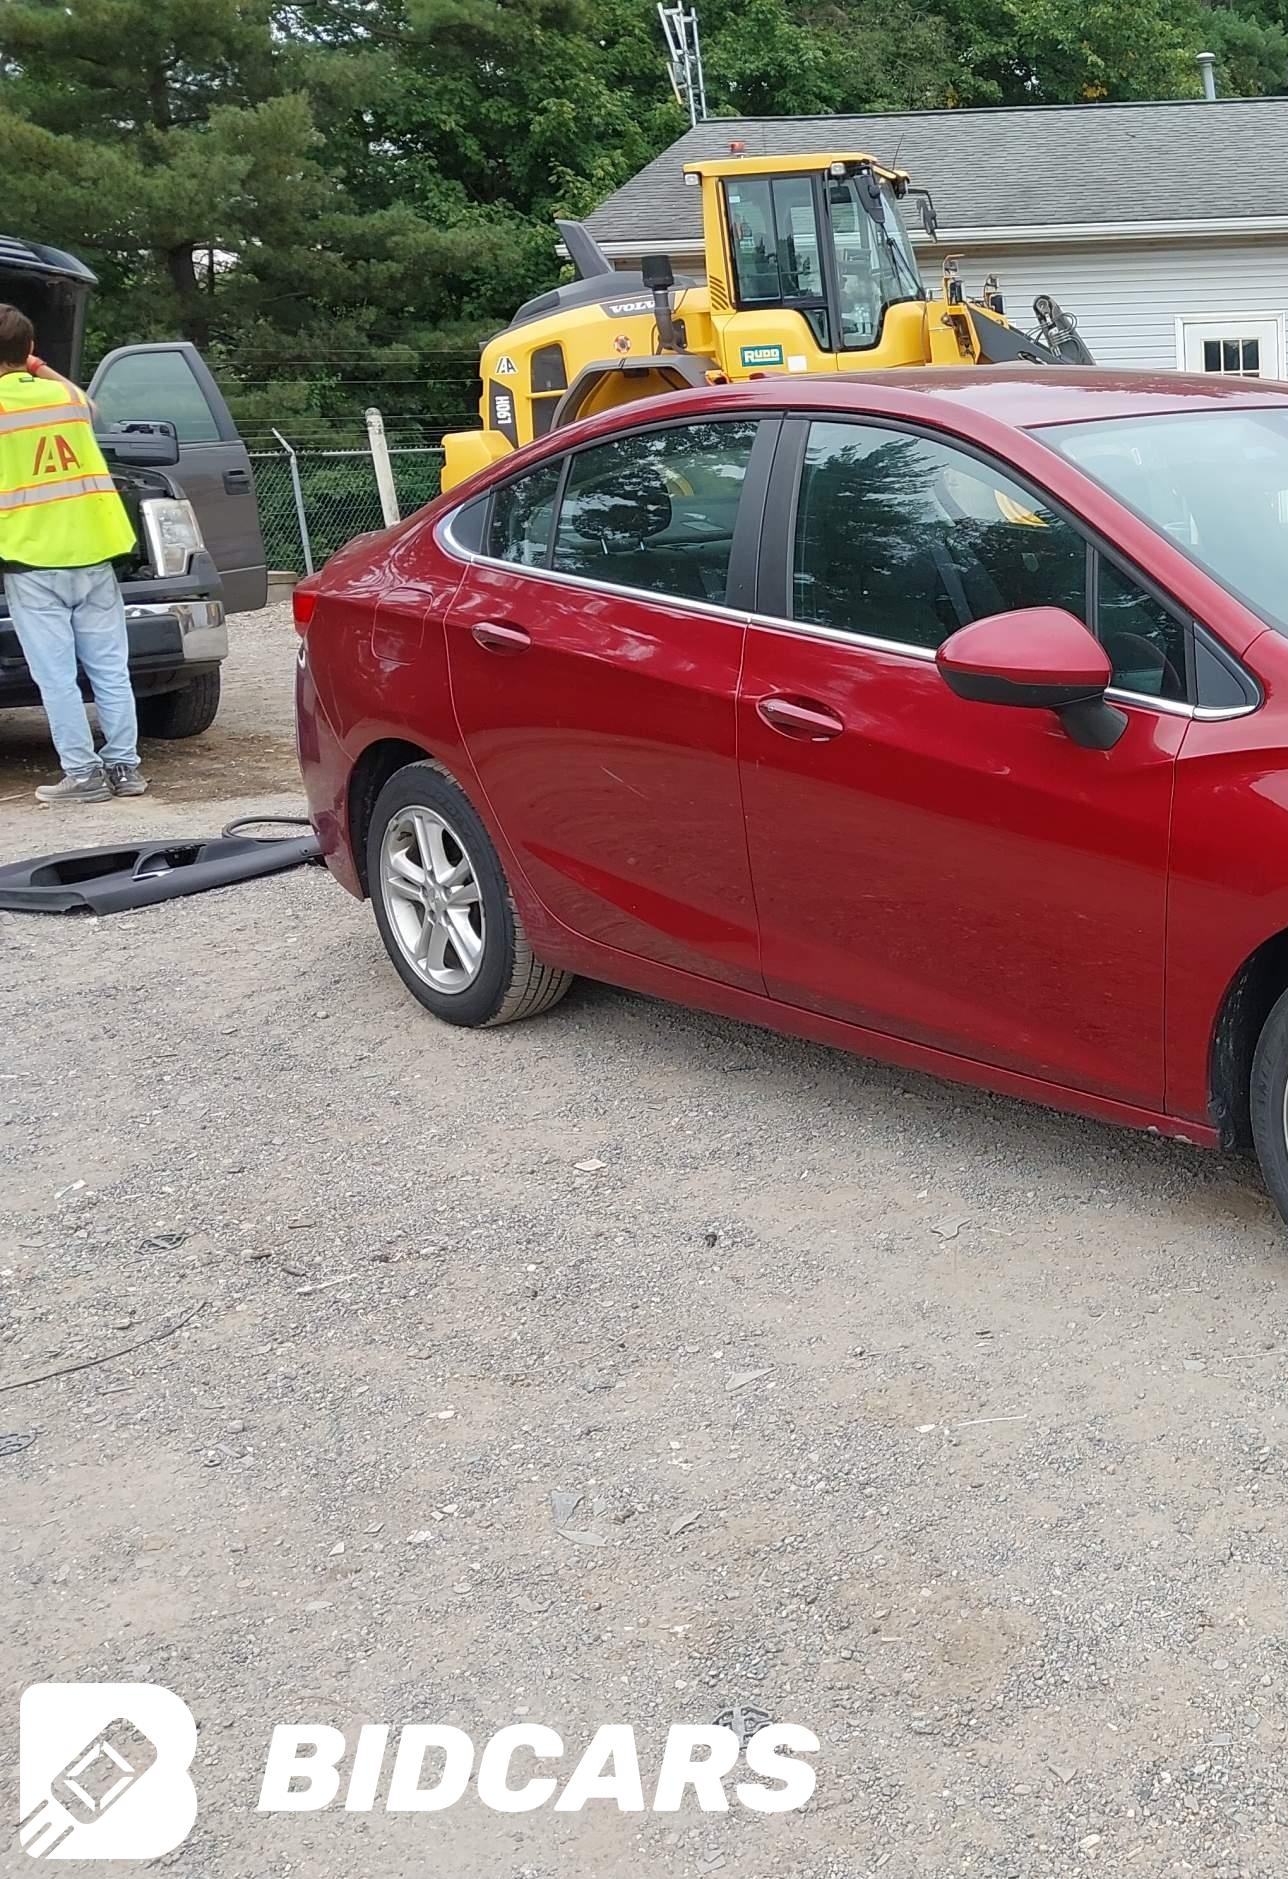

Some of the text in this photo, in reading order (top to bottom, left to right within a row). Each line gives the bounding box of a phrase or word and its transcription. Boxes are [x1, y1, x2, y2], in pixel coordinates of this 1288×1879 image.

[609, 300, 656, 314] VOLV
[744, 348, 780, 363] RUDD
[495, 395, 512, 424] L90H
